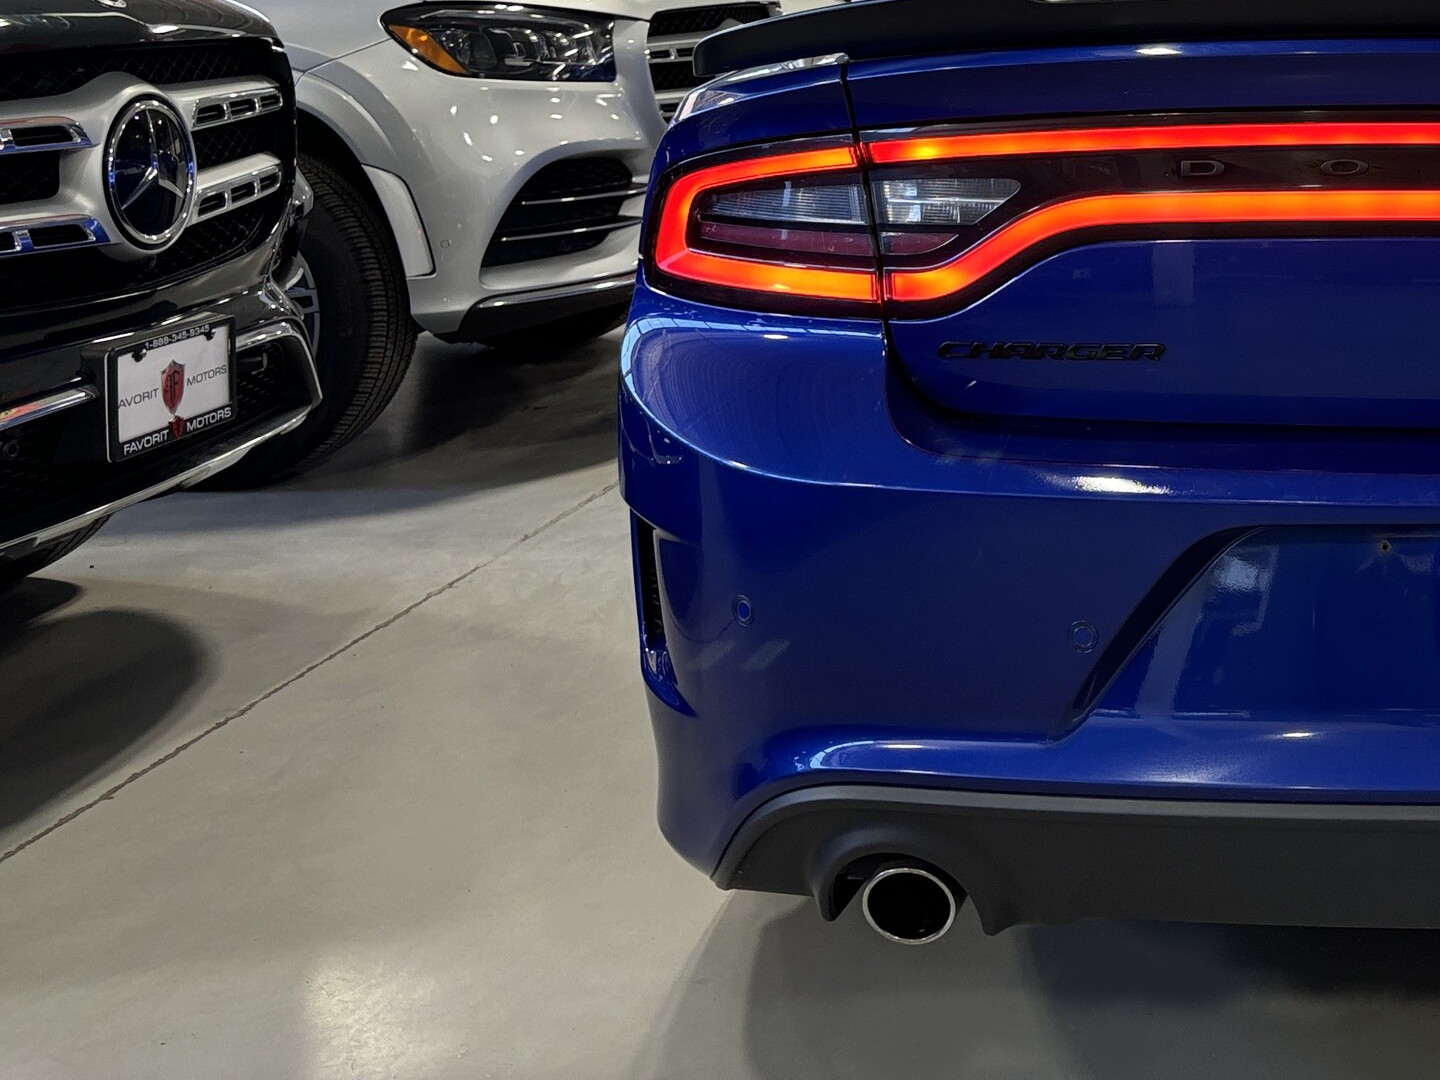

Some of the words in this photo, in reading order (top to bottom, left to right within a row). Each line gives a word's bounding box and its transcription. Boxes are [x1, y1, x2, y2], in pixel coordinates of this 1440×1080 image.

[937, 341, 1166, 361] CHARGER
[118, 388, 160, 409] AVORIT
[186, 364, 227, 387] MOTORS
[123, 429, 169, 456] FAVORIT
[186, 407, 231, 432] MOTORS
